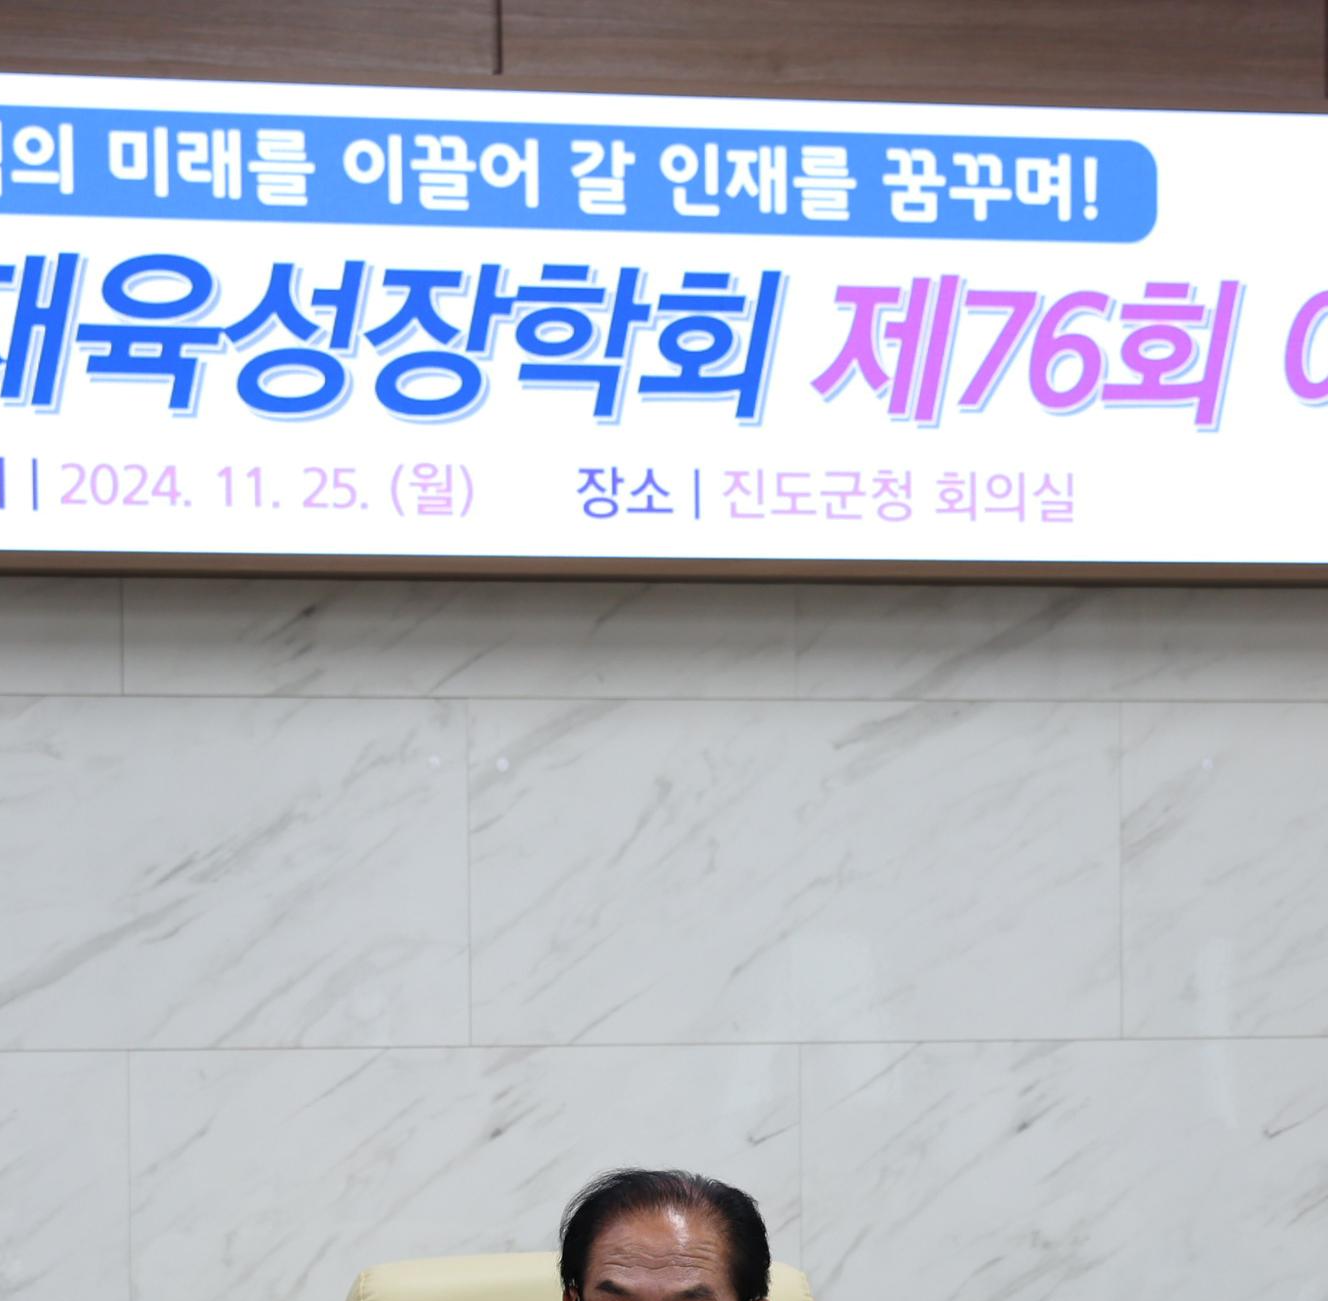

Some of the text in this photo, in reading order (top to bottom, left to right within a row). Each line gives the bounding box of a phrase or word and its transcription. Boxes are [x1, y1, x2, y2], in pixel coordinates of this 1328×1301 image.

[108, 126, 316, 206] 미래를
[343, 134, 539, 211] 이끌어
[570, 140, 636, 215] 갈
[659, 143, 857, 221] 인재를
[881, 148, 1100, 224] 꿈꾸며!
[810, 273, 1246, 429] 제76회
[59, 462, 193, 507] 2024.
[216, 465, 280, 508] 11.
[303, 466, 369, 509] 25.
[390, 462, 474, 517] (월)
[575, 465, 675, 520] 장소
[722, 468, 913, 522] 진도군청
[935, 471, 1075, 522] 회의실
